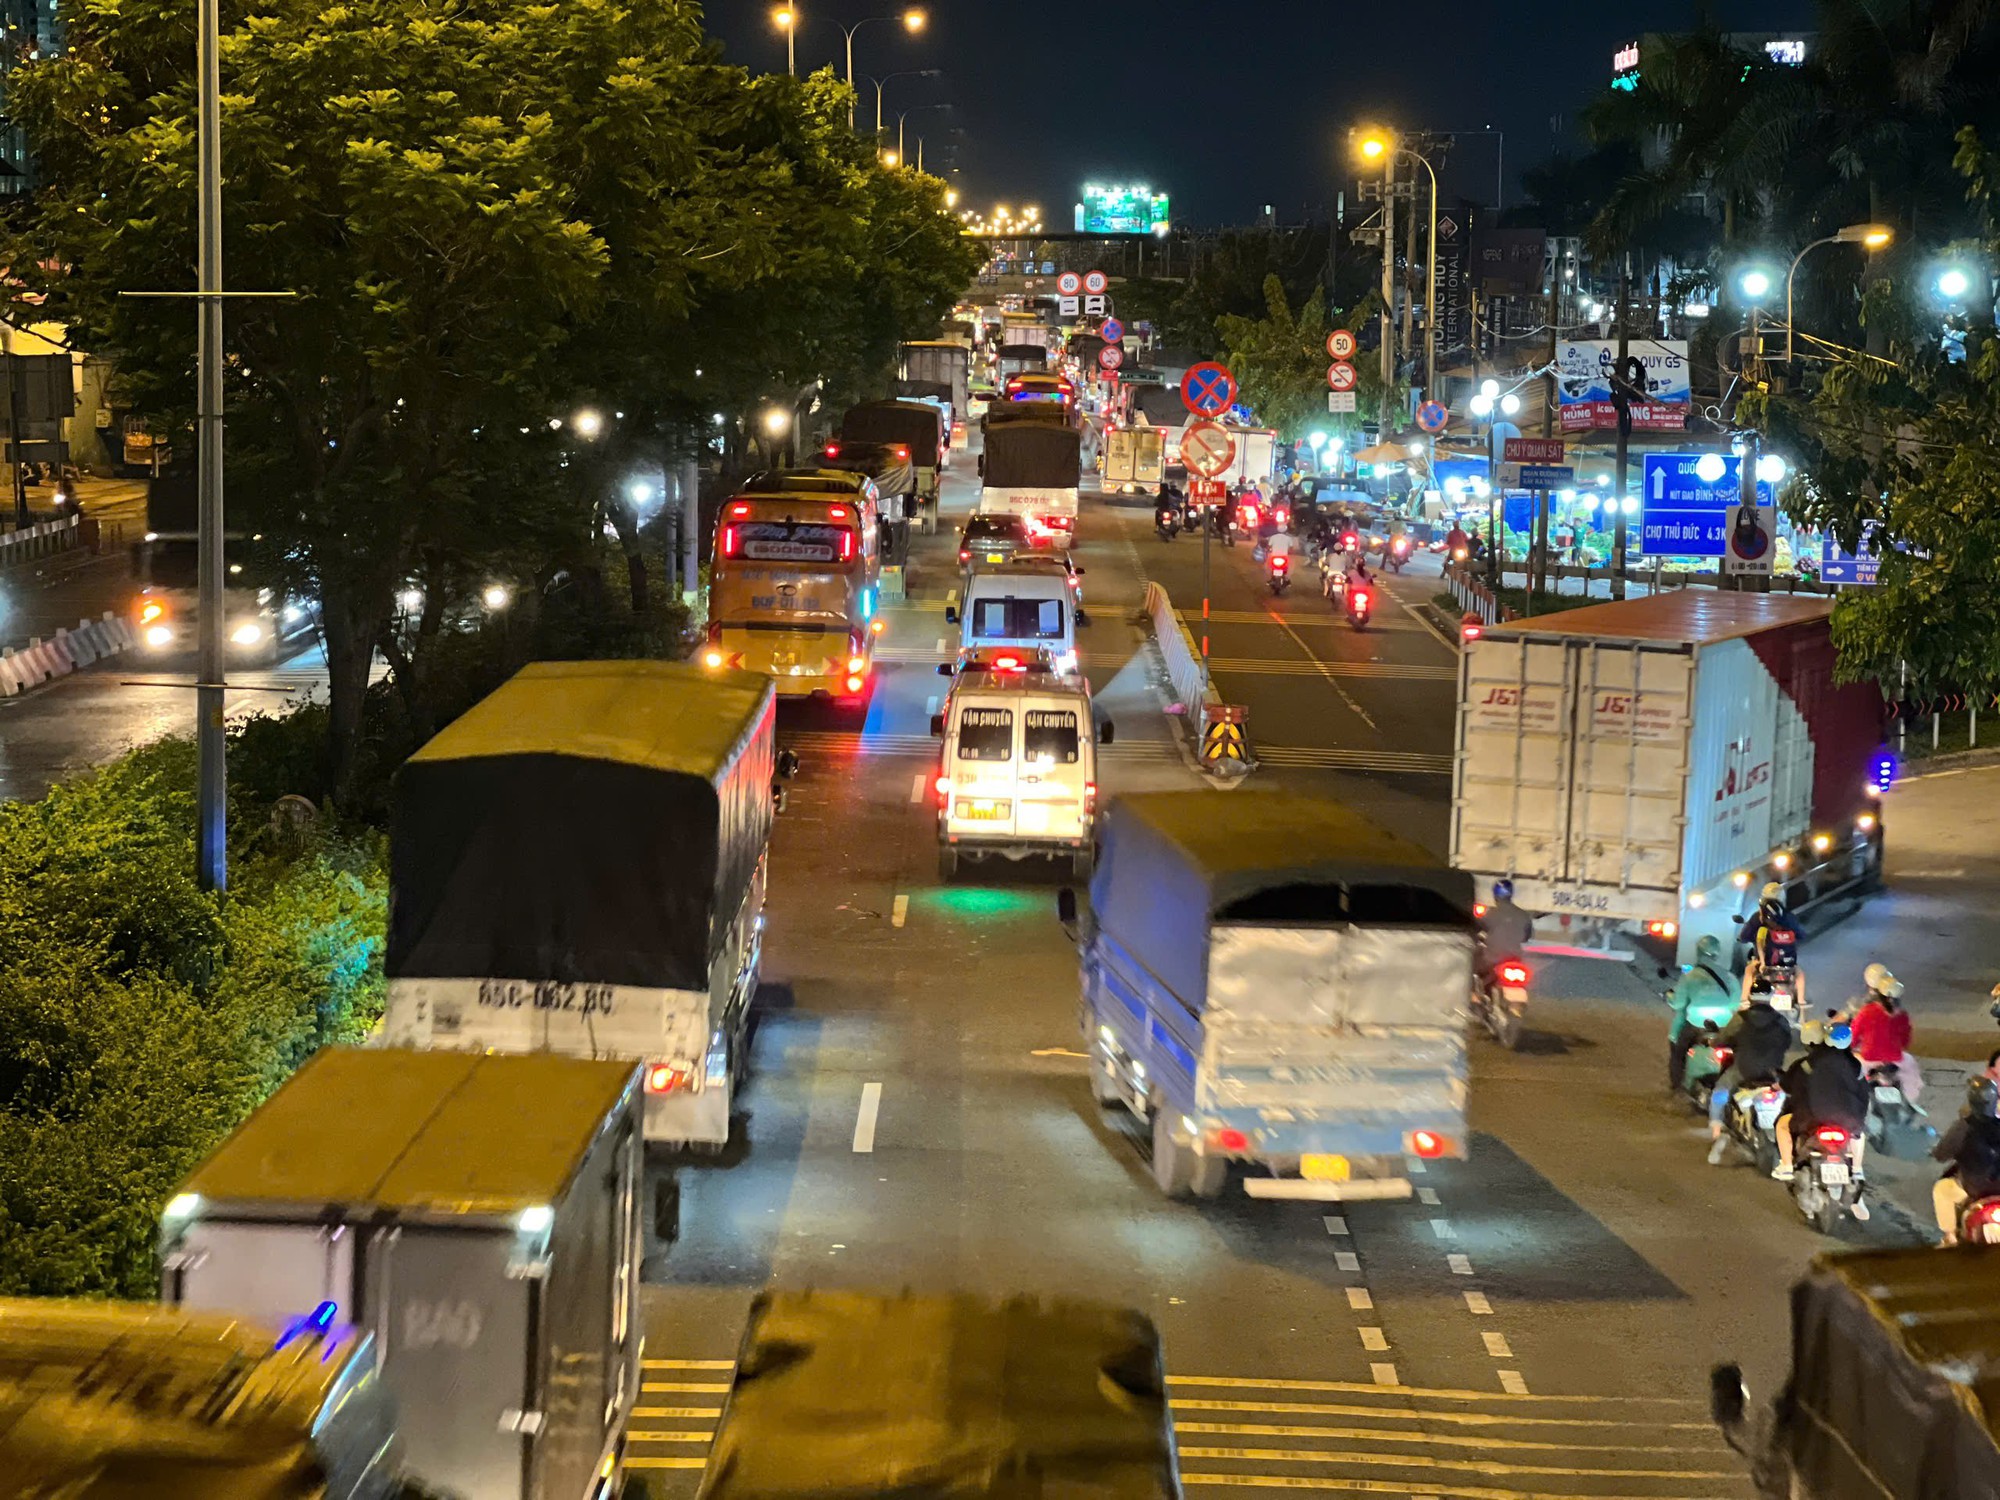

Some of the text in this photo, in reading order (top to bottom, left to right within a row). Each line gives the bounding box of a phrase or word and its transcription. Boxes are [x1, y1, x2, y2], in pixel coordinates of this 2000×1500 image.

[1435, 253, 1446, 287] HUY
[1063, 279, 1075, 288] 80
[1090, 277, 1100, 287] 60
[1336, 338, 1348, 350] 50
[1664, 356, 1681, 368] GS
[1527, 444, 1546, 457] QUAN
[1548, 443, 1562, 458] SÁT
[1678, 458, 1697, 474] QUỐ
[1682, 490, 1694, 500] GIAO
[1695, 486, 1713, 501] BÌNH
[1645, 521, 1726, 541] CHỢ THỦ ĐỨC 4.3K
[963, 710, 979, 727] VẬN
[1027, 711, 1042, 729] VẬN
